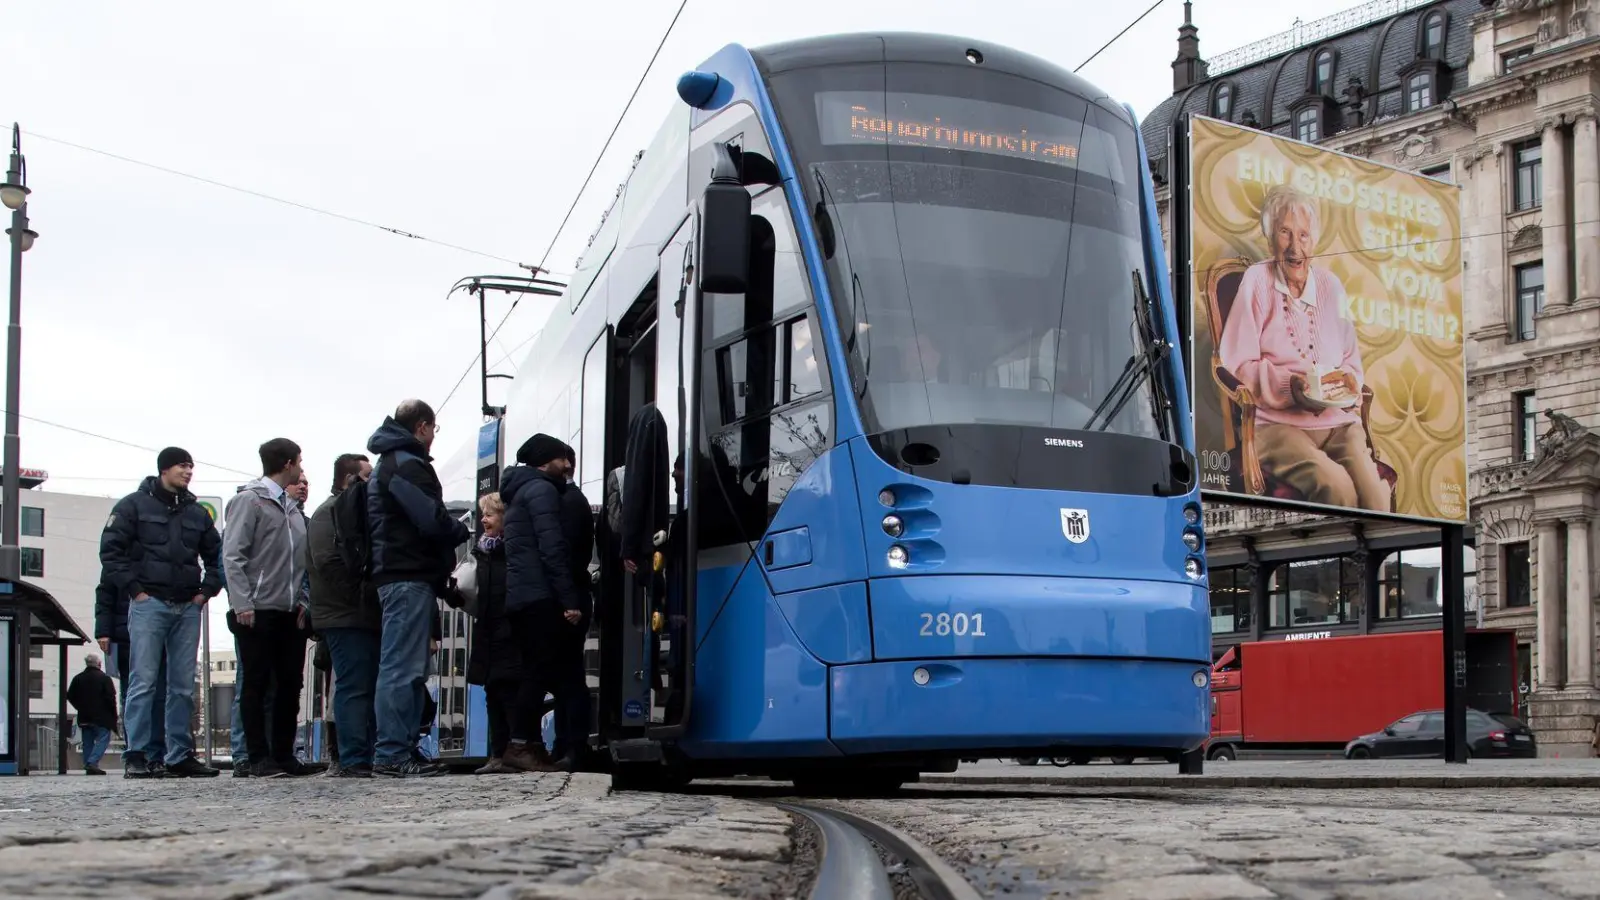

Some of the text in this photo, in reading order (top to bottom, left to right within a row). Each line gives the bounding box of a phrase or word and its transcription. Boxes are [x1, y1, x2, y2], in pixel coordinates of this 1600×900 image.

[1238, 152, 1441, 226] EIN GRÖSSERES
[1363, 224, 1441, 265] STÜCK
[1380, 267, 1443, 300] VOM
[1338, 294, 1458, 341] KUCHEN?
[1044, 437, 1084, 448] SIEMENS
[1201, 449, 1231, 471] 100
[1202, 472, 1231, 486] JAHRE
[919, 611, 986, 637] 2801
[1285, 631, 1331, 641] AMBIENTE
